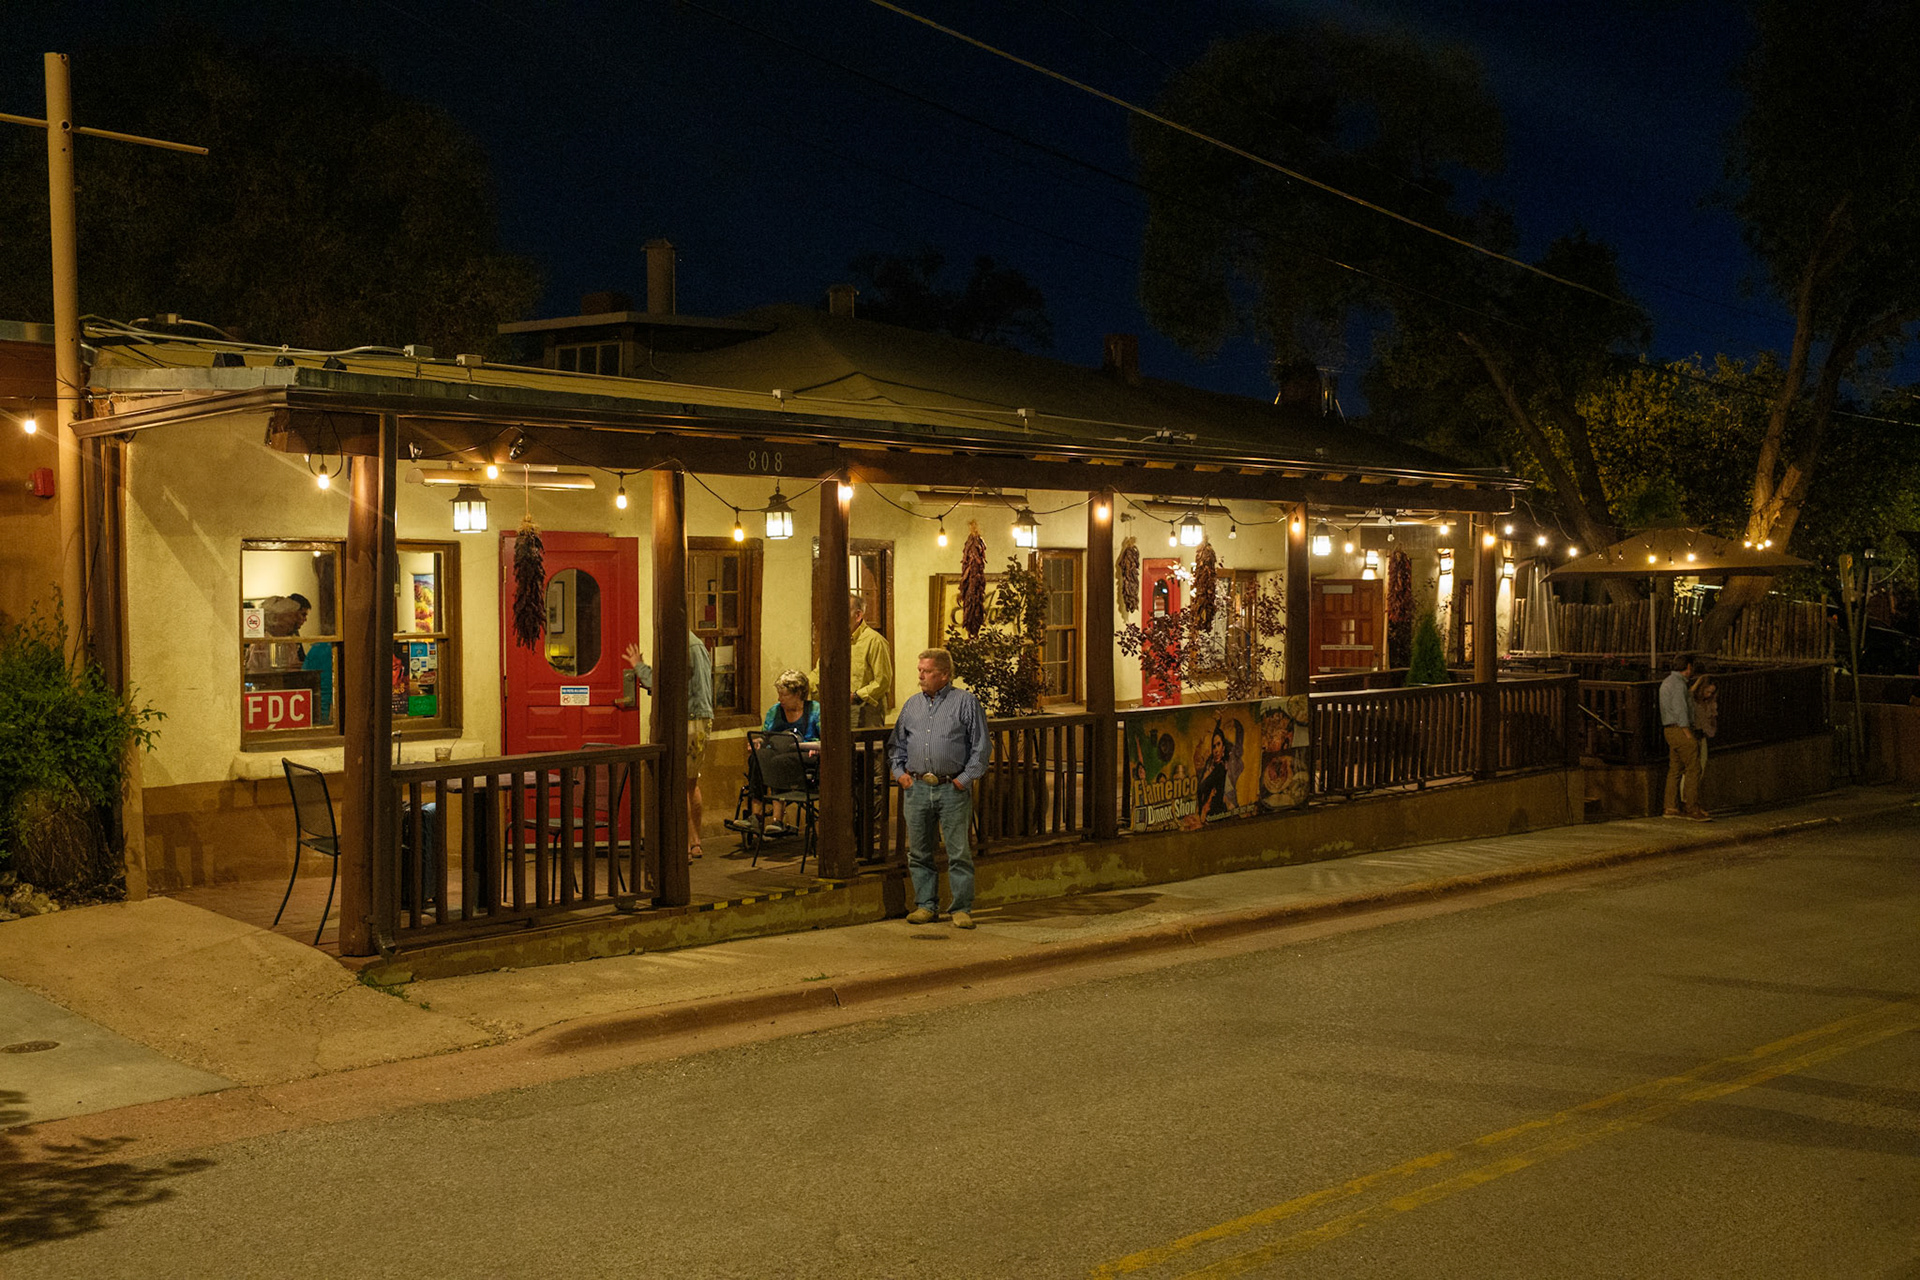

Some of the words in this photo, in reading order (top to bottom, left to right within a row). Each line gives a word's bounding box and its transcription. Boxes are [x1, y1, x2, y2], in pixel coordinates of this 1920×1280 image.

[748, 450, 783, 472] 808
[247, 694, 305, 725] FDC
[1134, 776, 1198, 807] Flamenco
[1147, 804, 1174, 825] Dinner
[1174, 798, 1197, 818] Show
